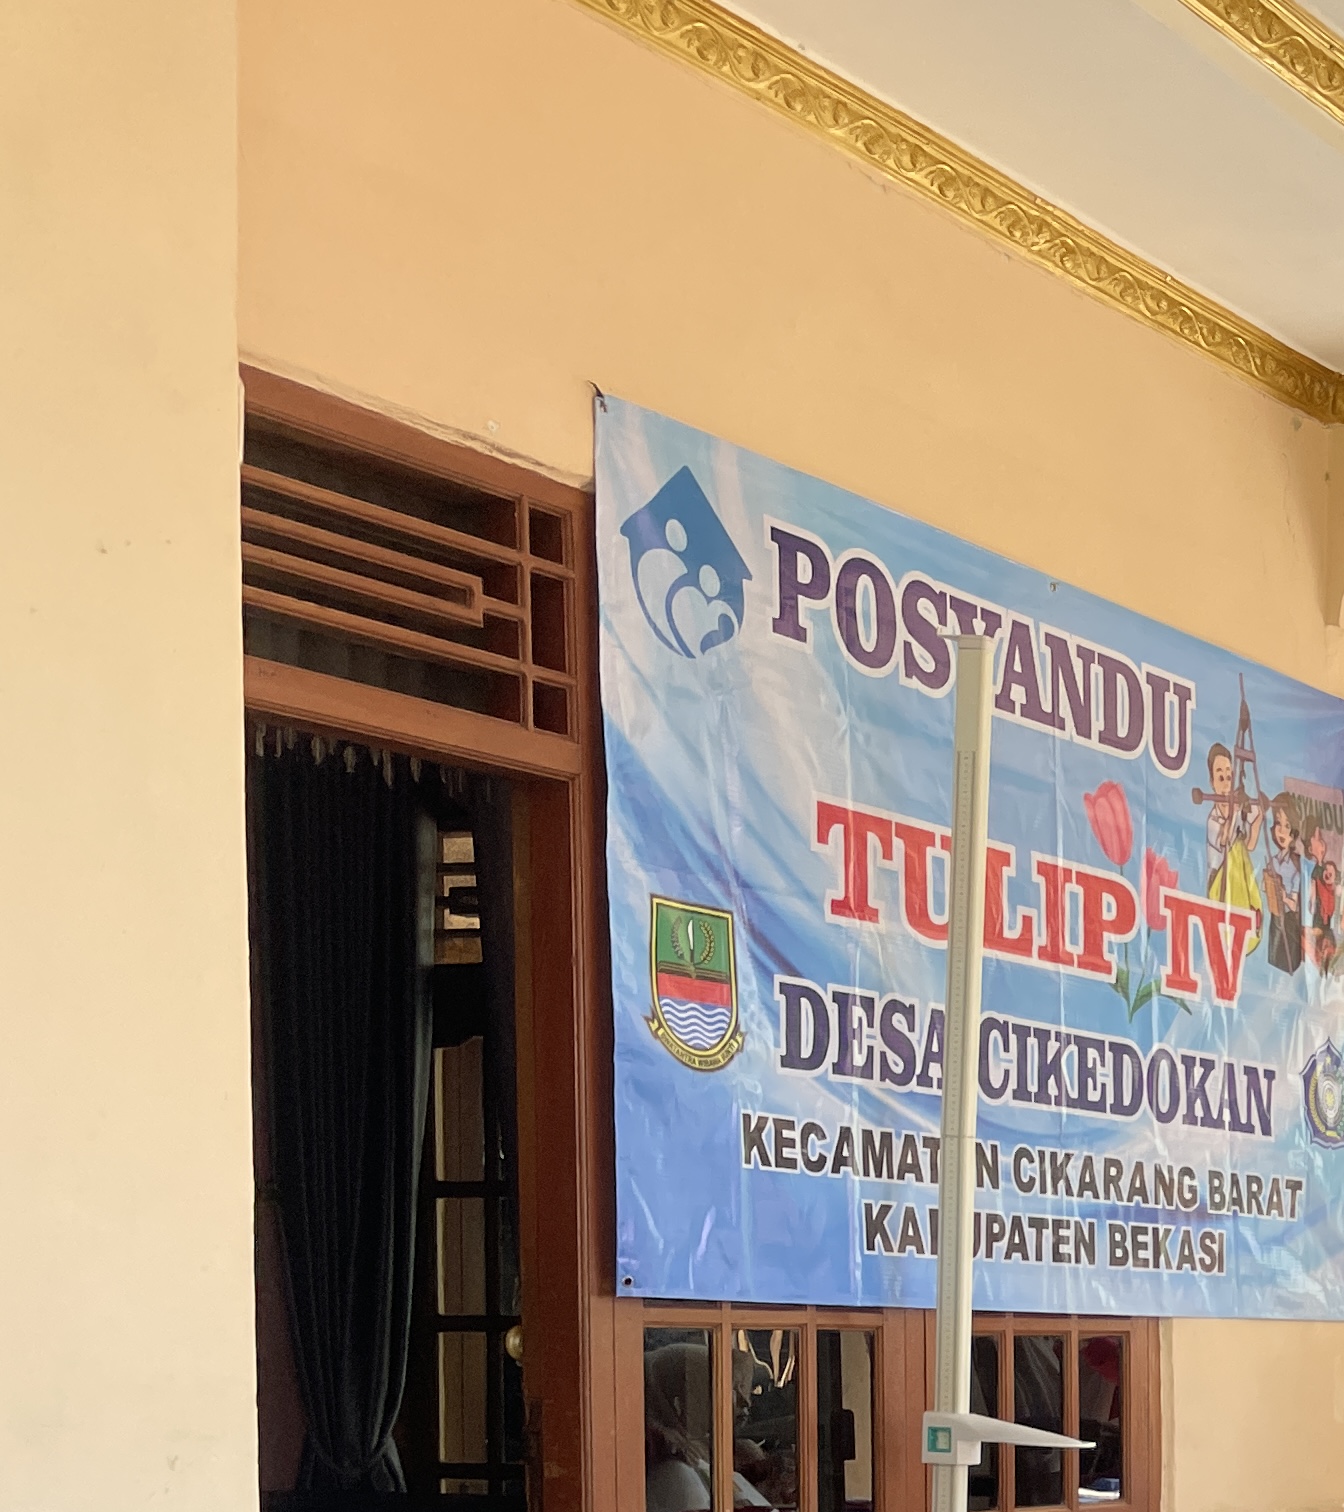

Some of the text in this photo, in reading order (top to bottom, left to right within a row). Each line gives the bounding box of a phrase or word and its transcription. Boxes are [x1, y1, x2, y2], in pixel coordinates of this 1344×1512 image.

[816, 800, 1257, 1001] TULIP IV
[779, 981, 1276, 1136] DESA CIKEDOKAN
[742, 1112, 1303, 1220] KECAMATN CIKARANG BARAT
[1108, 1222, 1226, 1274] BEKASI
